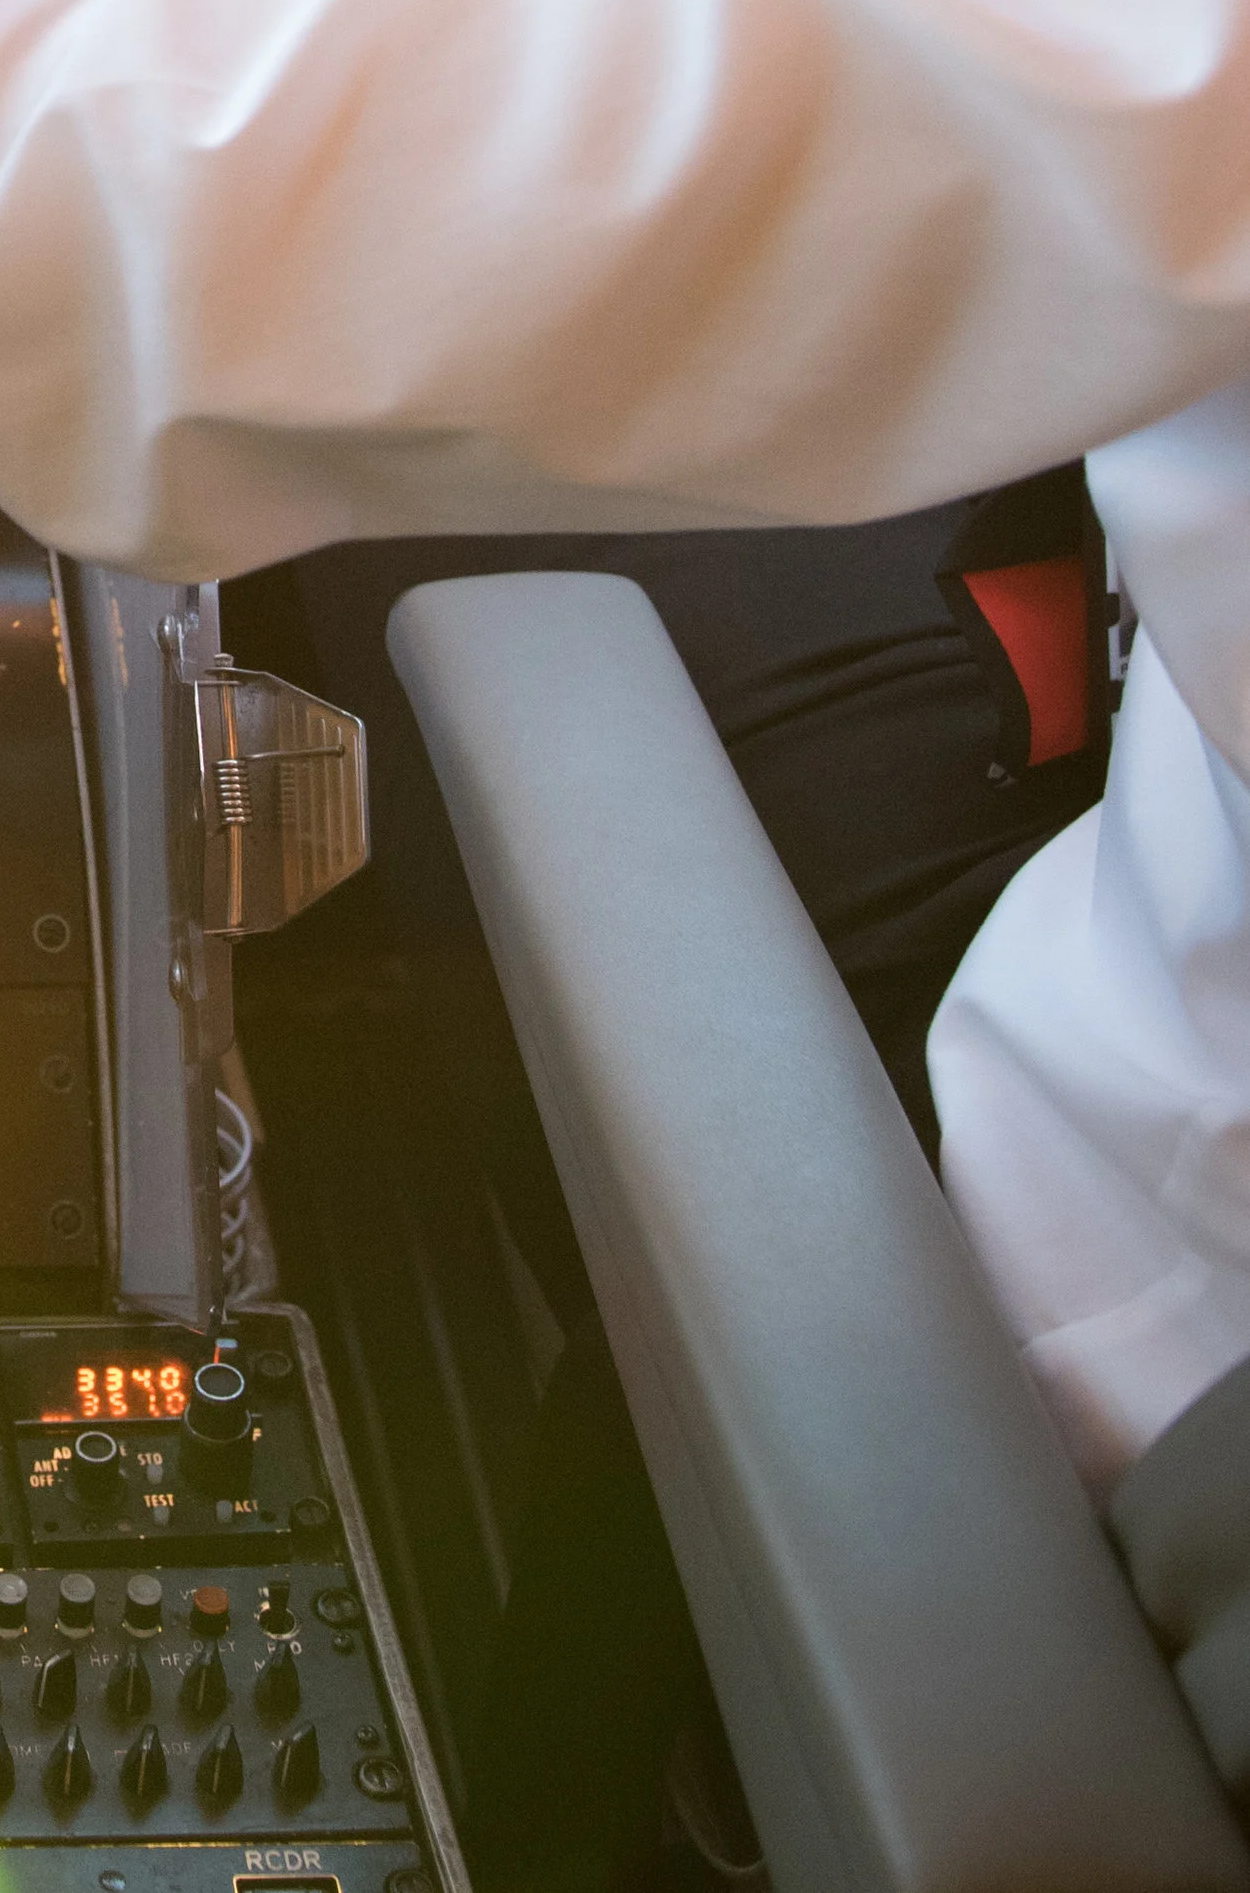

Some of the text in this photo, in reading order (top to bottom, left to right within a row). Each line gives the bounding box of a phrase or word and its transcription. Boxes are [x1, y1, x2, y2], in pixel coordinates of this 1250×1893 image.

[53, 1446, 72, 1459] AD
[137, 1452, 163, 1466] STO
[34, 1459, 59, 1473] ANT
[30, 1475, 55, 1487] OFF
[144, 1494, 175, 1507] TEST
[234, 1500, 259, 1513] ACT
[193, 1640, 236, 1653] OLY
[245, 1850, 323, 1872] RCDR
